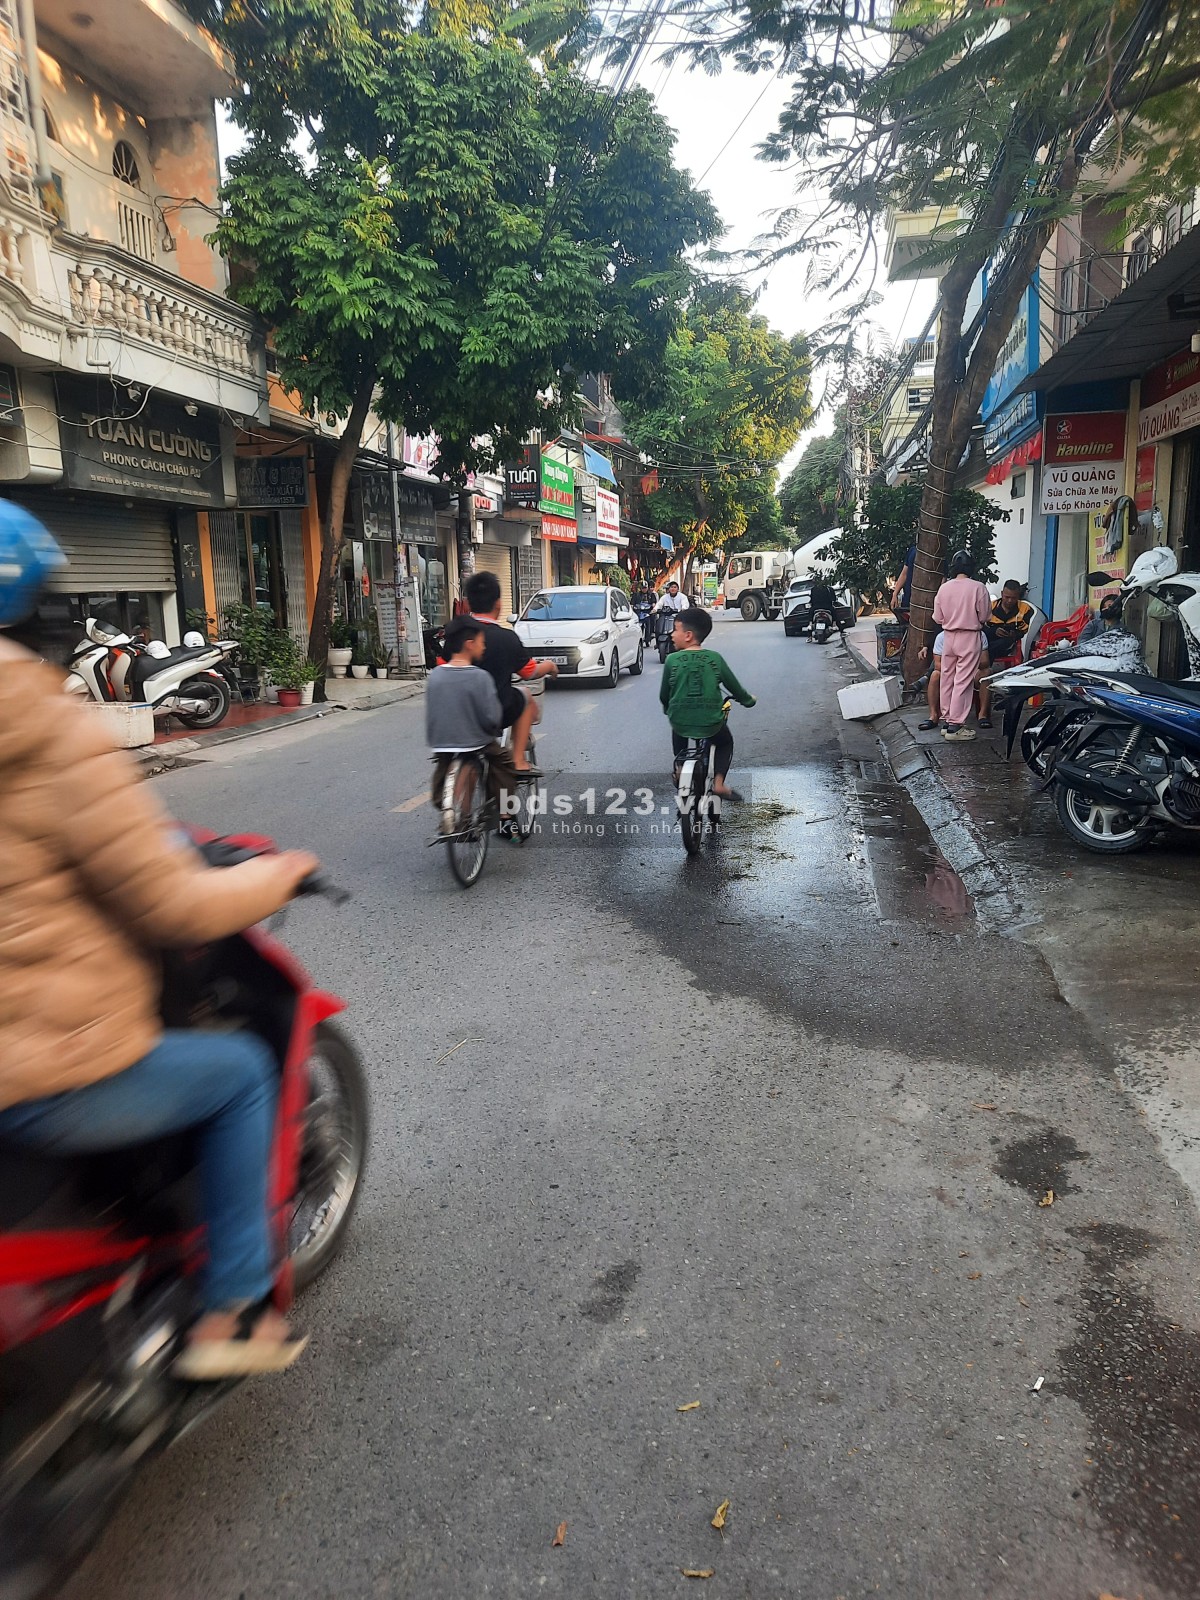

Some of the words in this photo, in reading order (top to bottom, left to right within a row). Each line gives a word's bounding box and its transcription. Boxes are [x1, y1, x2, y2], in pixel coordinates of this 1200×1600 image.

[1150, 403, 1180, 438] QUẢNG
[1056, 440, 1114, 457] Havoline
[103, 451, 139, 469] PHONG
[140, 457, 167, 473] CÁCH
[508, 465, 537, 484] TUẤN
[1052, 470, 1068, 483] VŨ
[1071, 466, 1116, 482] QUẢNG
[1047, 487, 1063, 498] Sửa
[1065, 486, 1087, 497] Chữa
[1088, 486, 1099, 495] Xe
[1101, 485, 1118, 497] Máy
[1043, 501, 1054, 511] Vá
[1056, 499, 1072, 512] Lốp
